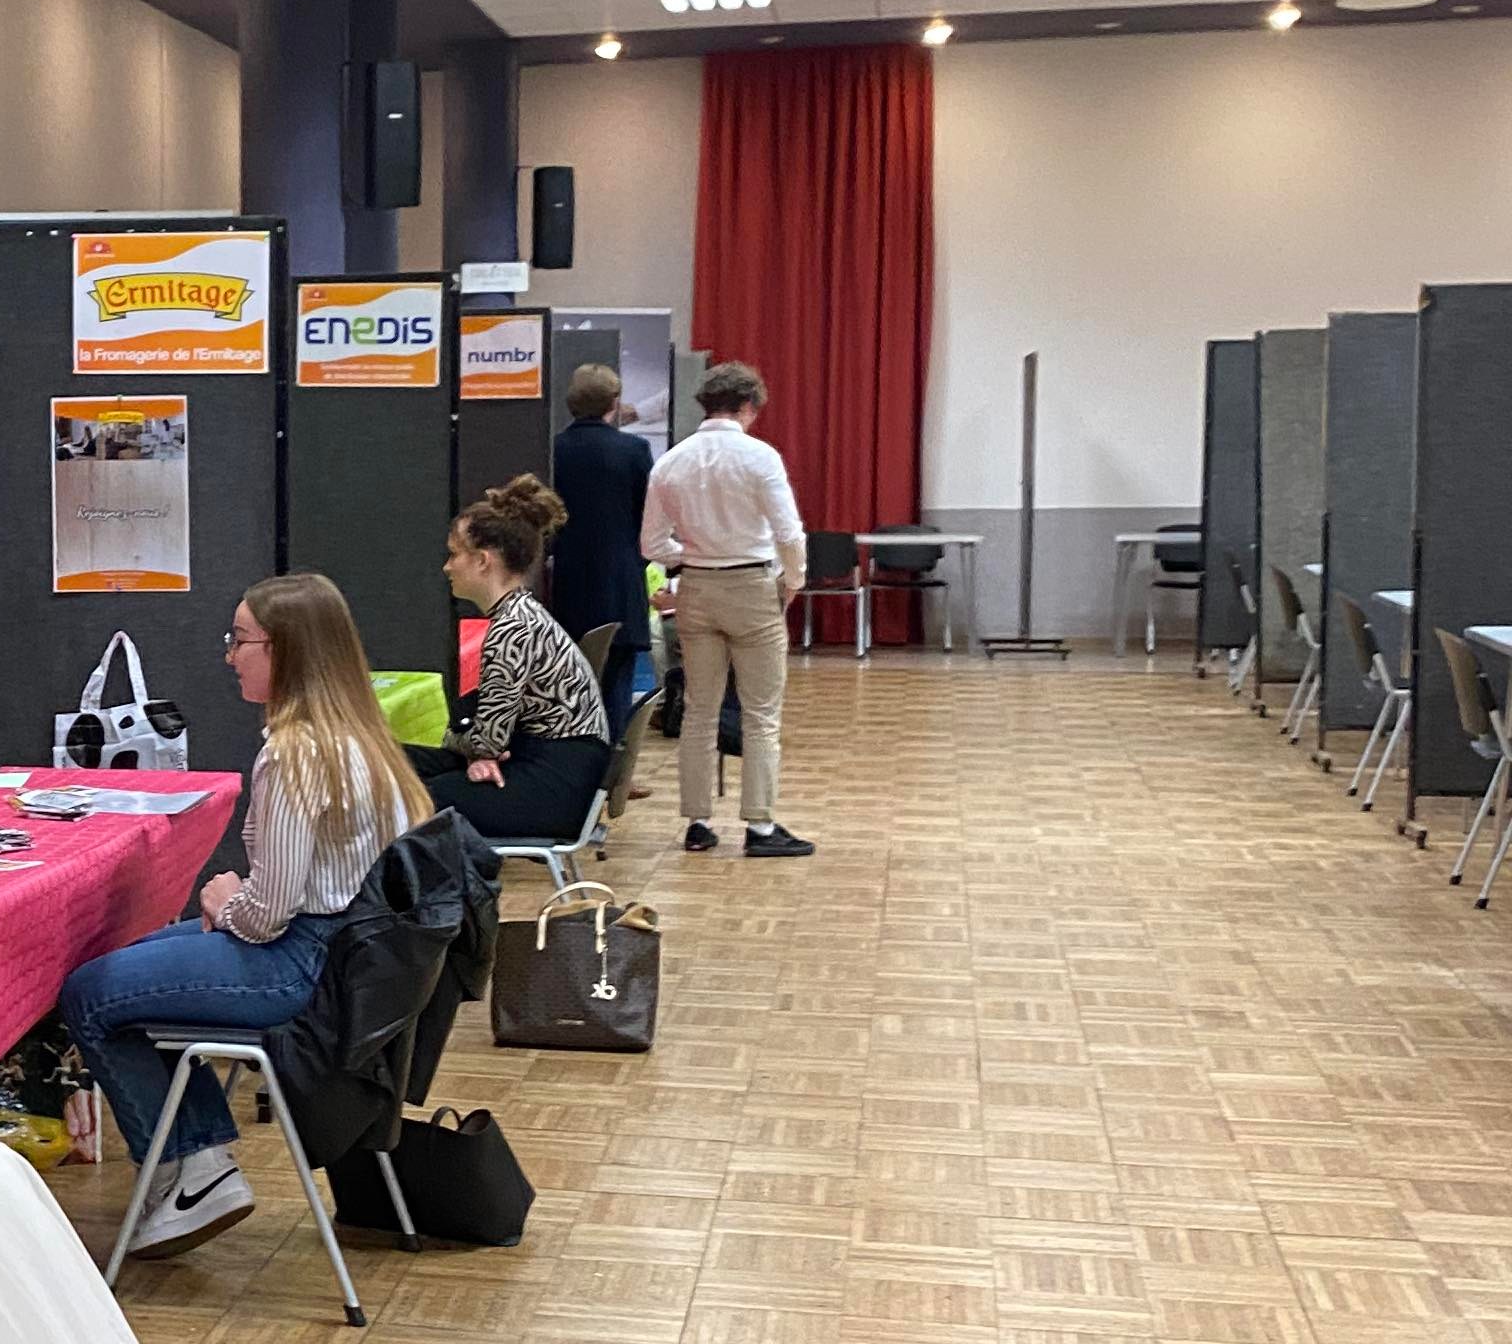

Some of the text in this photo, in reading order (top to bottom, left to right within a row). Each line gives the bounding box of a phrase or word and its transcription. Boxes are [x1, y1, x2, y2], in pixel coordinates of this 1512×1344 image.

[106, 279, 237, 310] Ermitage
[79, 348, 92, 362] la
[93, 348, 169, 364] Fromagerie
[172, 348, 191, 362] de
[467, 347, 536, 364] numbr
